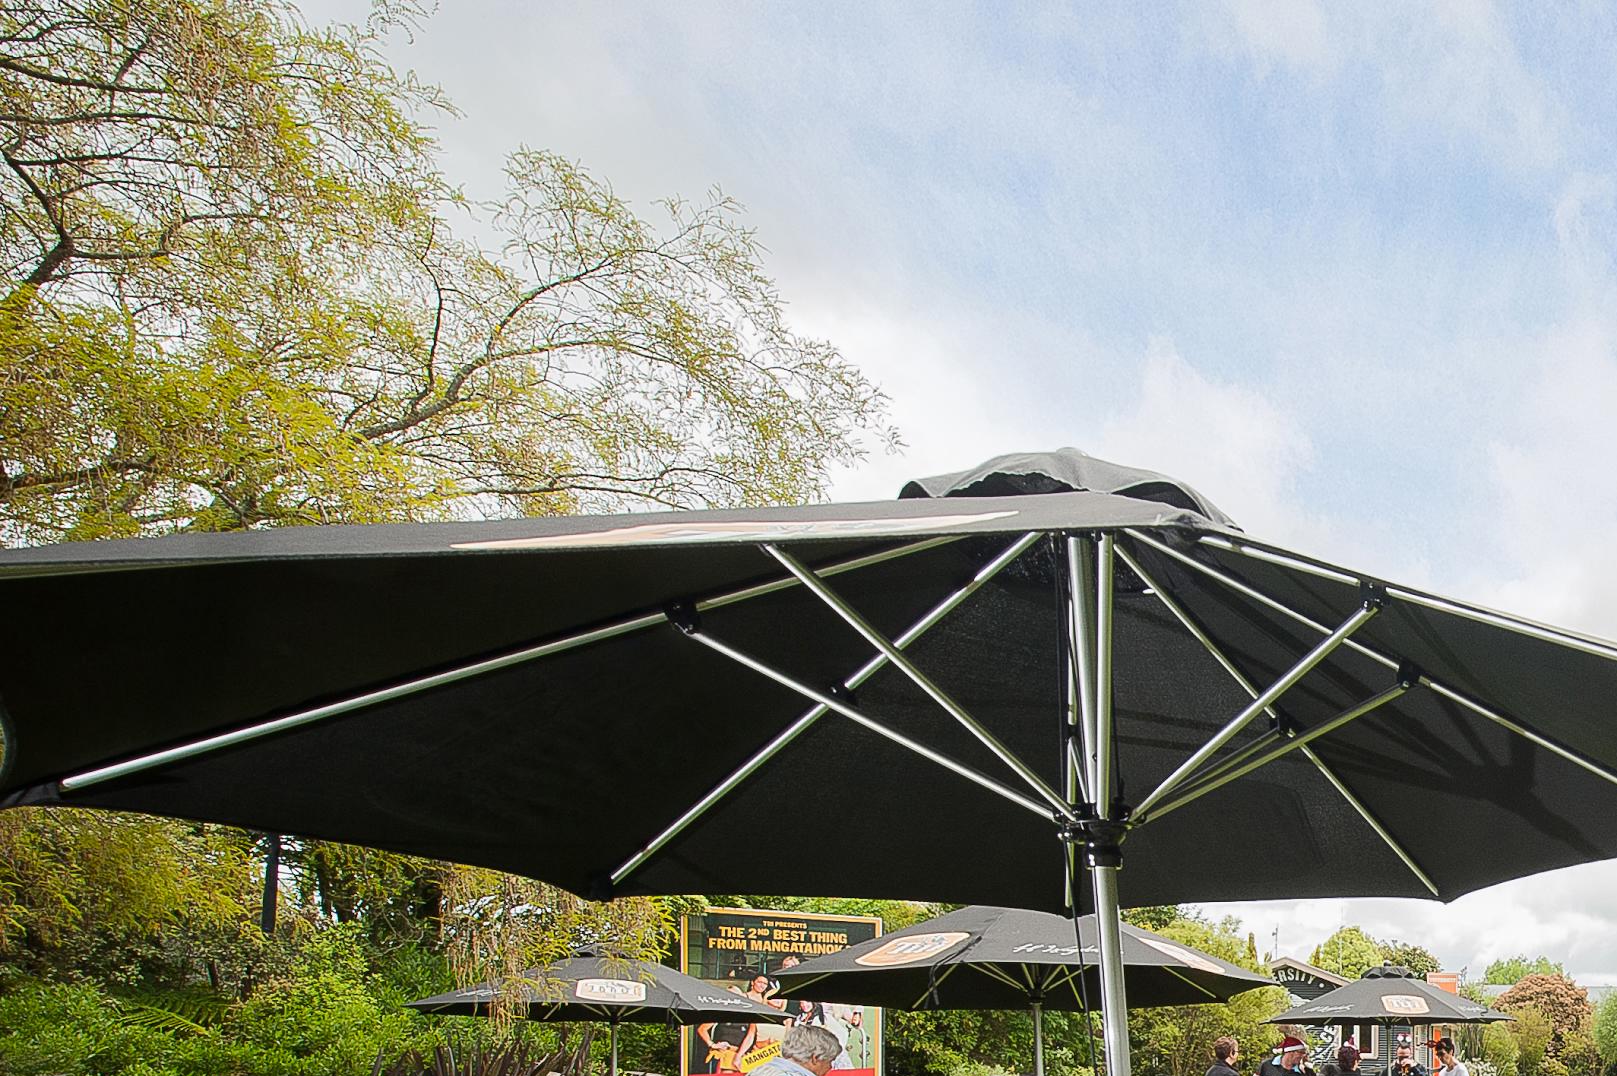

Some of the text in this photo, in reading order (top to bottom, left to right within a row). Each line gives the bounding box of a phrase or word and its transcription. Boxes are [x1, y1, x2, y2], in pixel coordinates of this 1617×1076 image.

[719, 926, 745, 938] THE
[773, 929, 807, 942] BEST
[808, 931, 848, 944] THING
[708, 938, 747, 950] FROM
